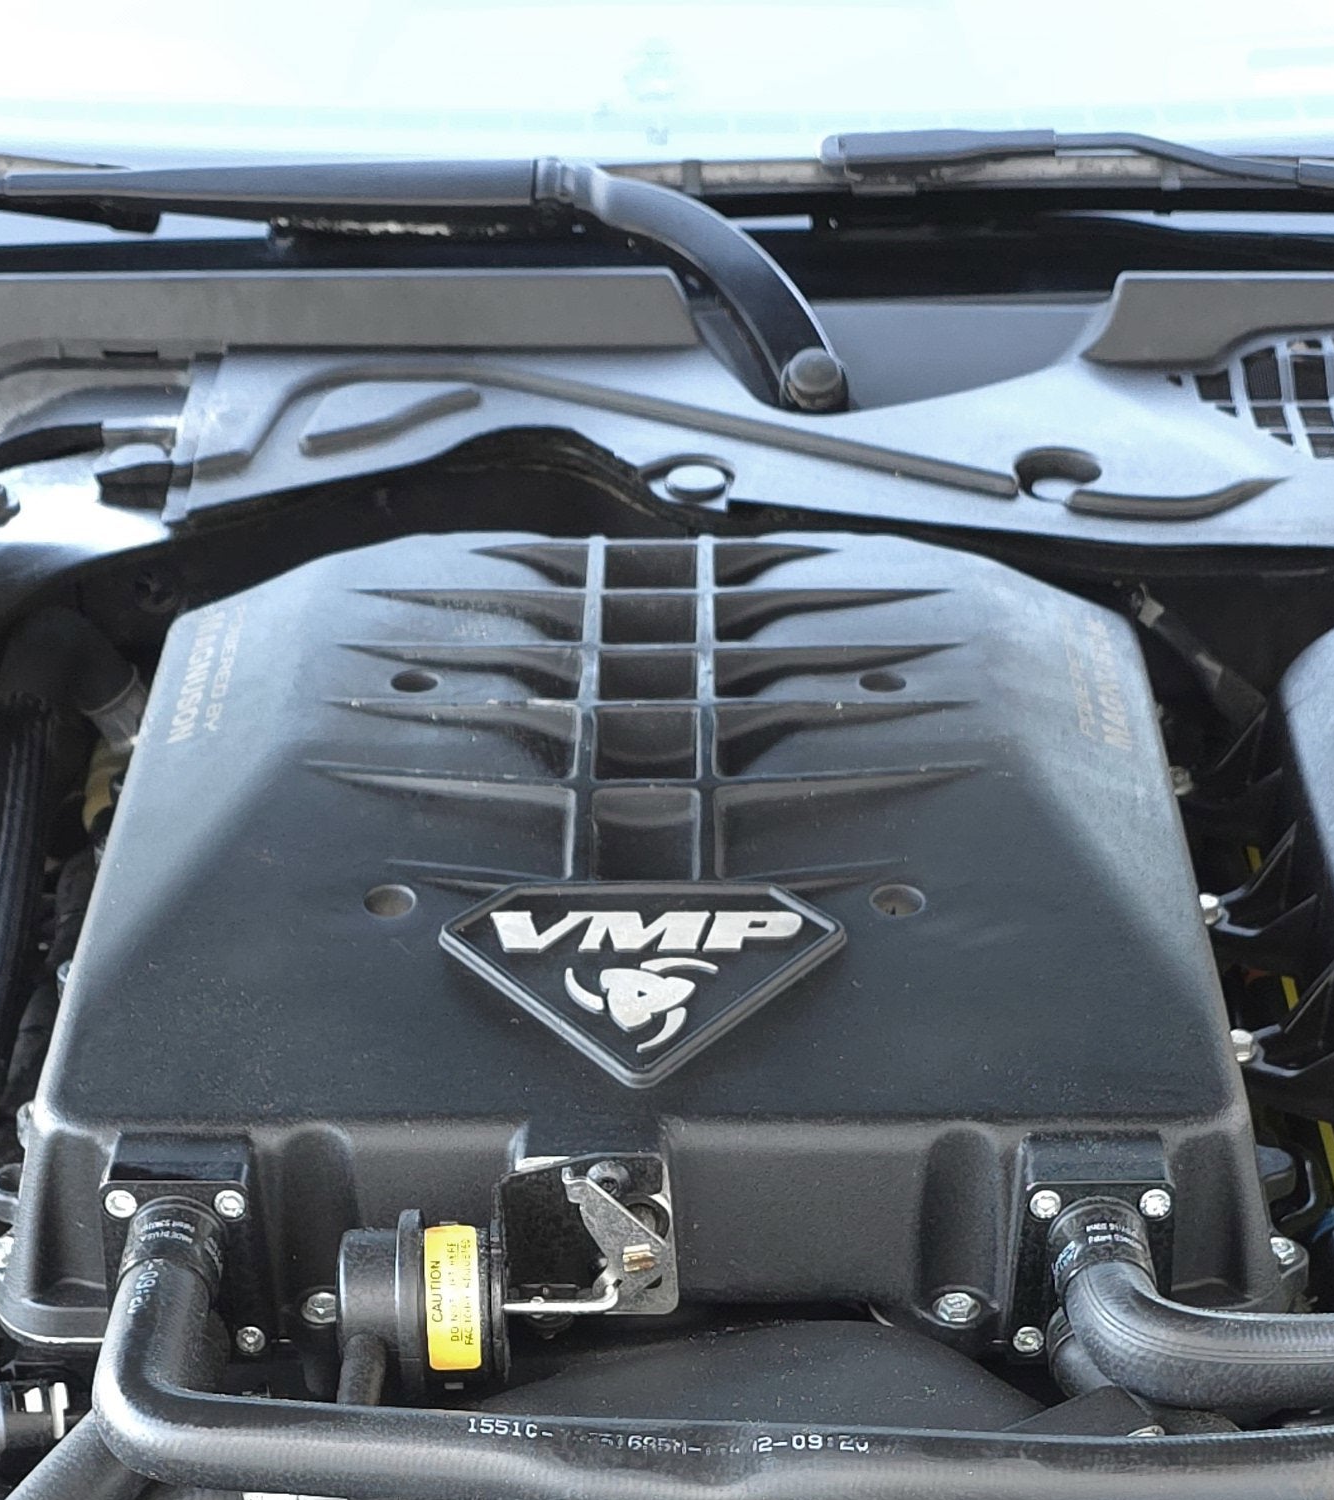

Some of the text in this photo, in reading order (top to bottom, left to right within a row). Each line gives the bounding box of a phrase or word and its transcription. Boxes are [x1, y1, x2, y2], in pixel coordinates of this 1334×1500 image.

[202, 703, 223, 732] BY
[489, 909, 805, 954] VMP
[429, 1260, 444, 1323] CAUTION
[450, 1326, 460, 1342] DO
